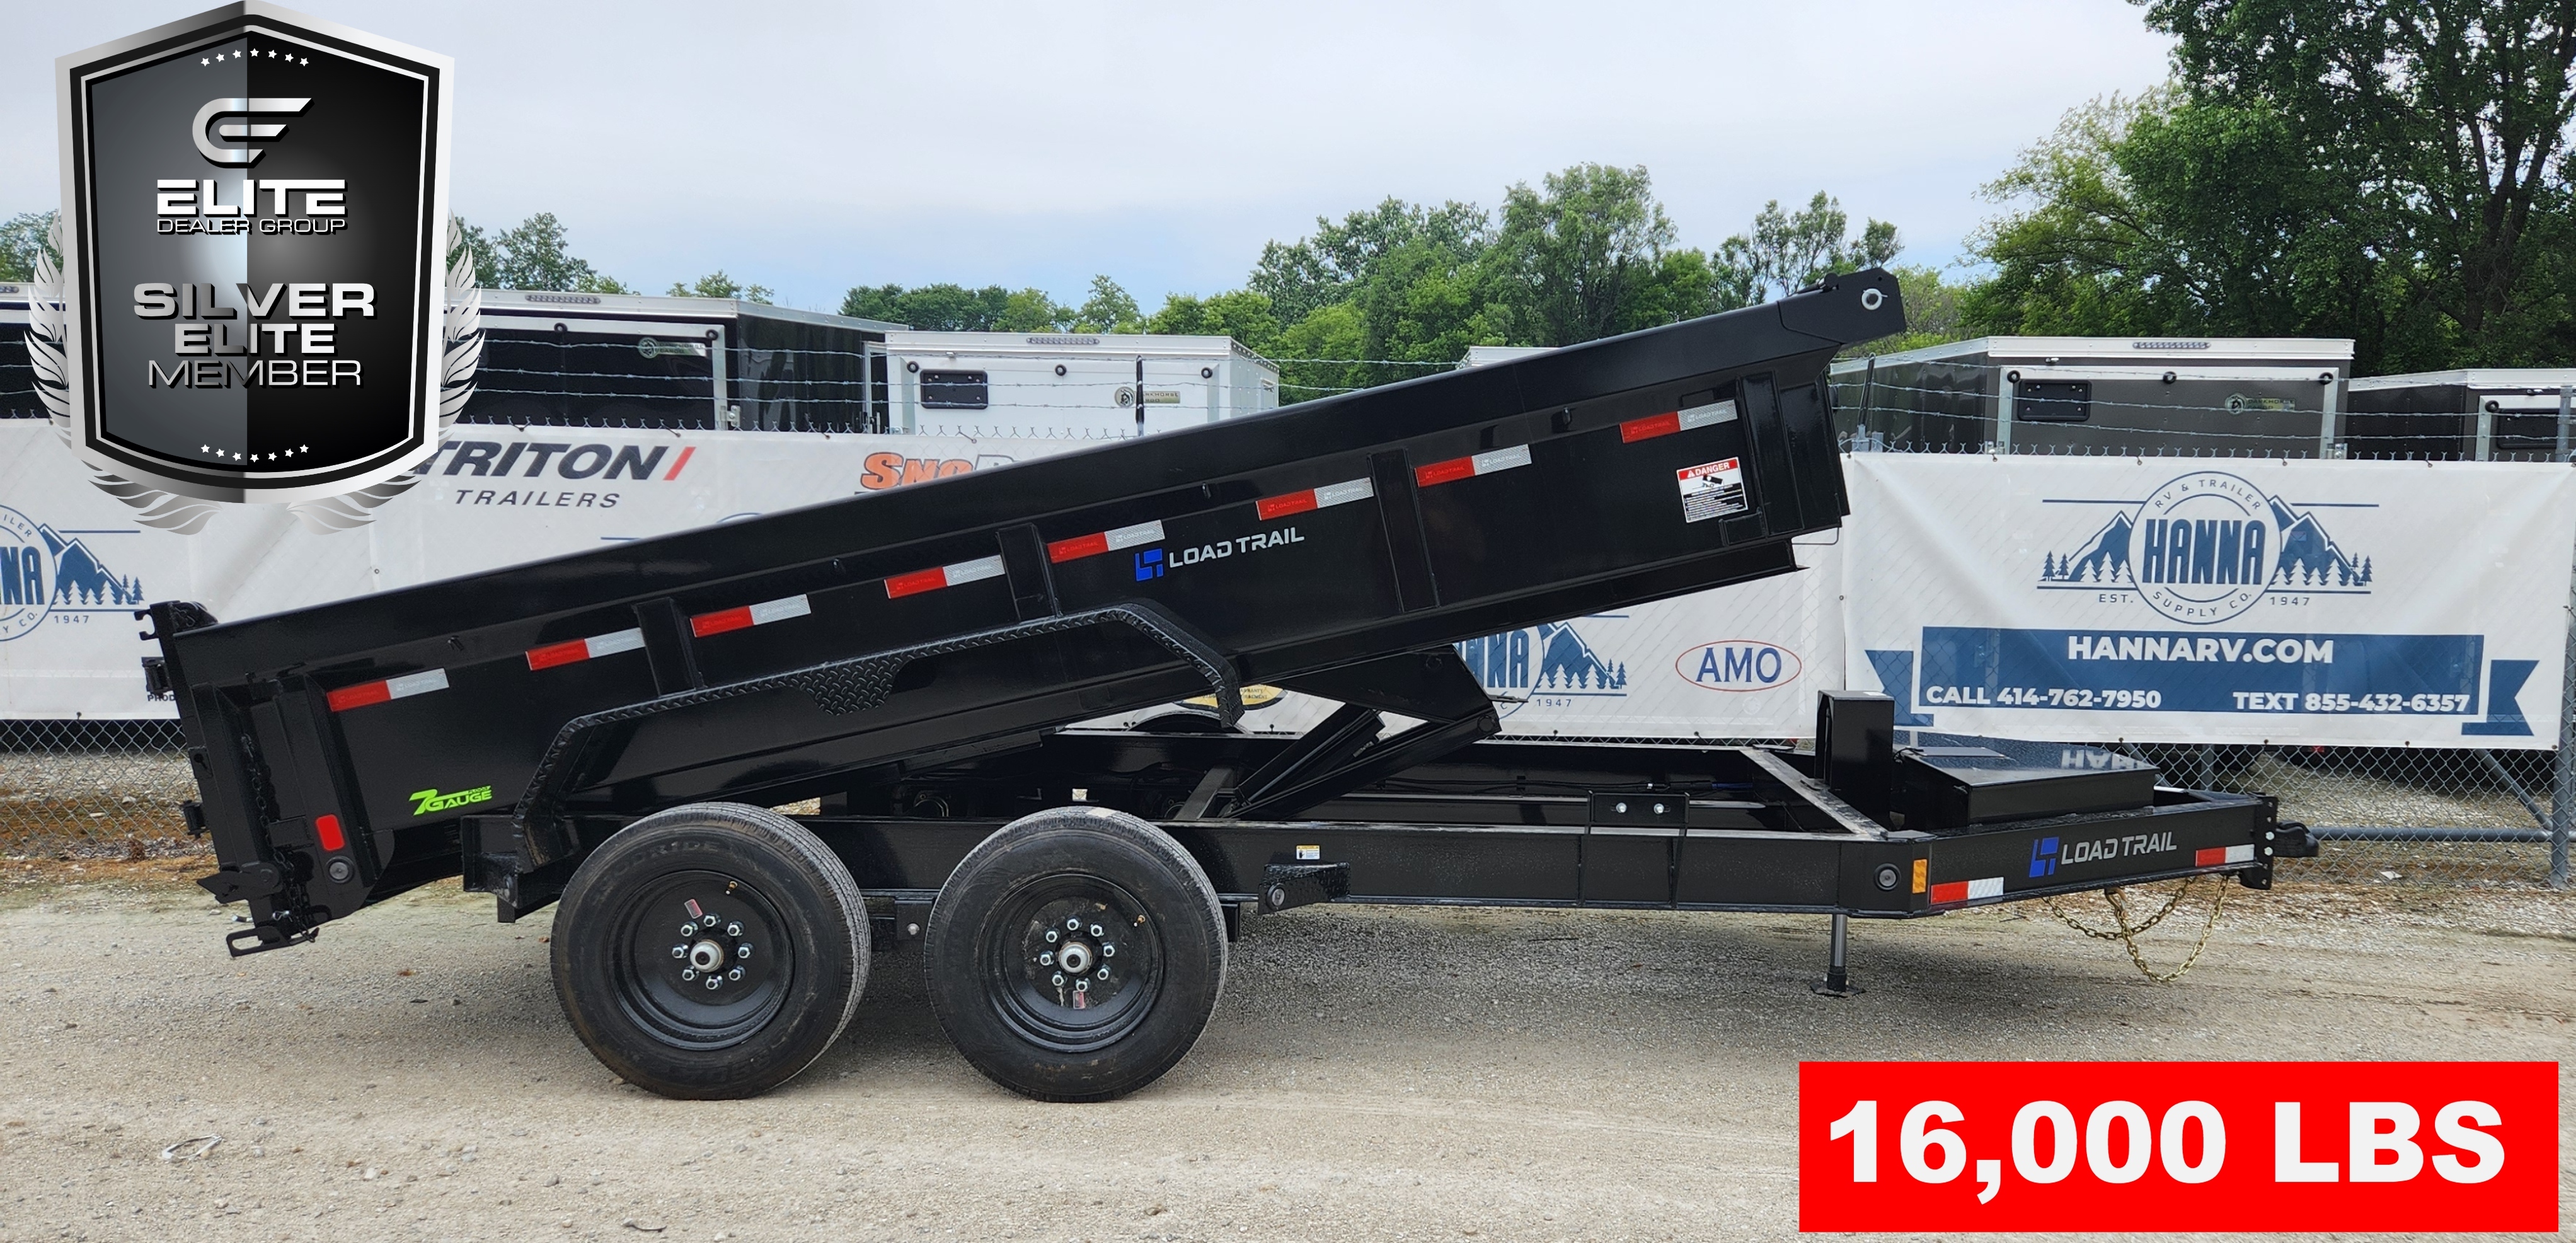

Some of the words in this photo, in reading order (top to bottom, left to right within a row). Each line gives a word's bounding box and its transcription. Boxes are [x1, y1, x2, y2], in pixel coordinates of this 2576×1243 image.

[413, 441, 670, 480] TRITON
[1695, 462, 1730, 476] DANGER
[455, 490, 621, 508] TRAILERS
[2154, 492, 2172, 508] RV
[2181, 483, 2190, 492] &
[2199, 479, 2261, 510] TRAILER
[1169, 540, 1233, 568] LOAD
[1236, 527, 1305, 553] TRAIL
[2142, 519, 2267, 585] HANNA
[2098, 594, 2135, 604] EST.
[2153, 591, 2217, 617] SUPPLY
[2229, 593, 2253, 610] CO.
[2269, 596, 2311, 606] 1947
[54, 615, 89, 623] 1947
[2067, 635, 2334, 664] HANNARV.COM
[1696, 647, 1782, 683] AMO
[1536, 698, 1572, 707] 1947
[1926, 686, 1991, 705] CALL
[1997, 687, 2162, 709] 414-762-7950
[2233, 691, 2299, 710] TEXT
[2304, 693, 2470, 712] 855-432-6357
[408, 789, 438, 816] 7
[425, 789, 492, 811] GAUGE
[2061, 838, 2119, 865] LOAD
[2122, 831, 2178, 857] TRAIL
